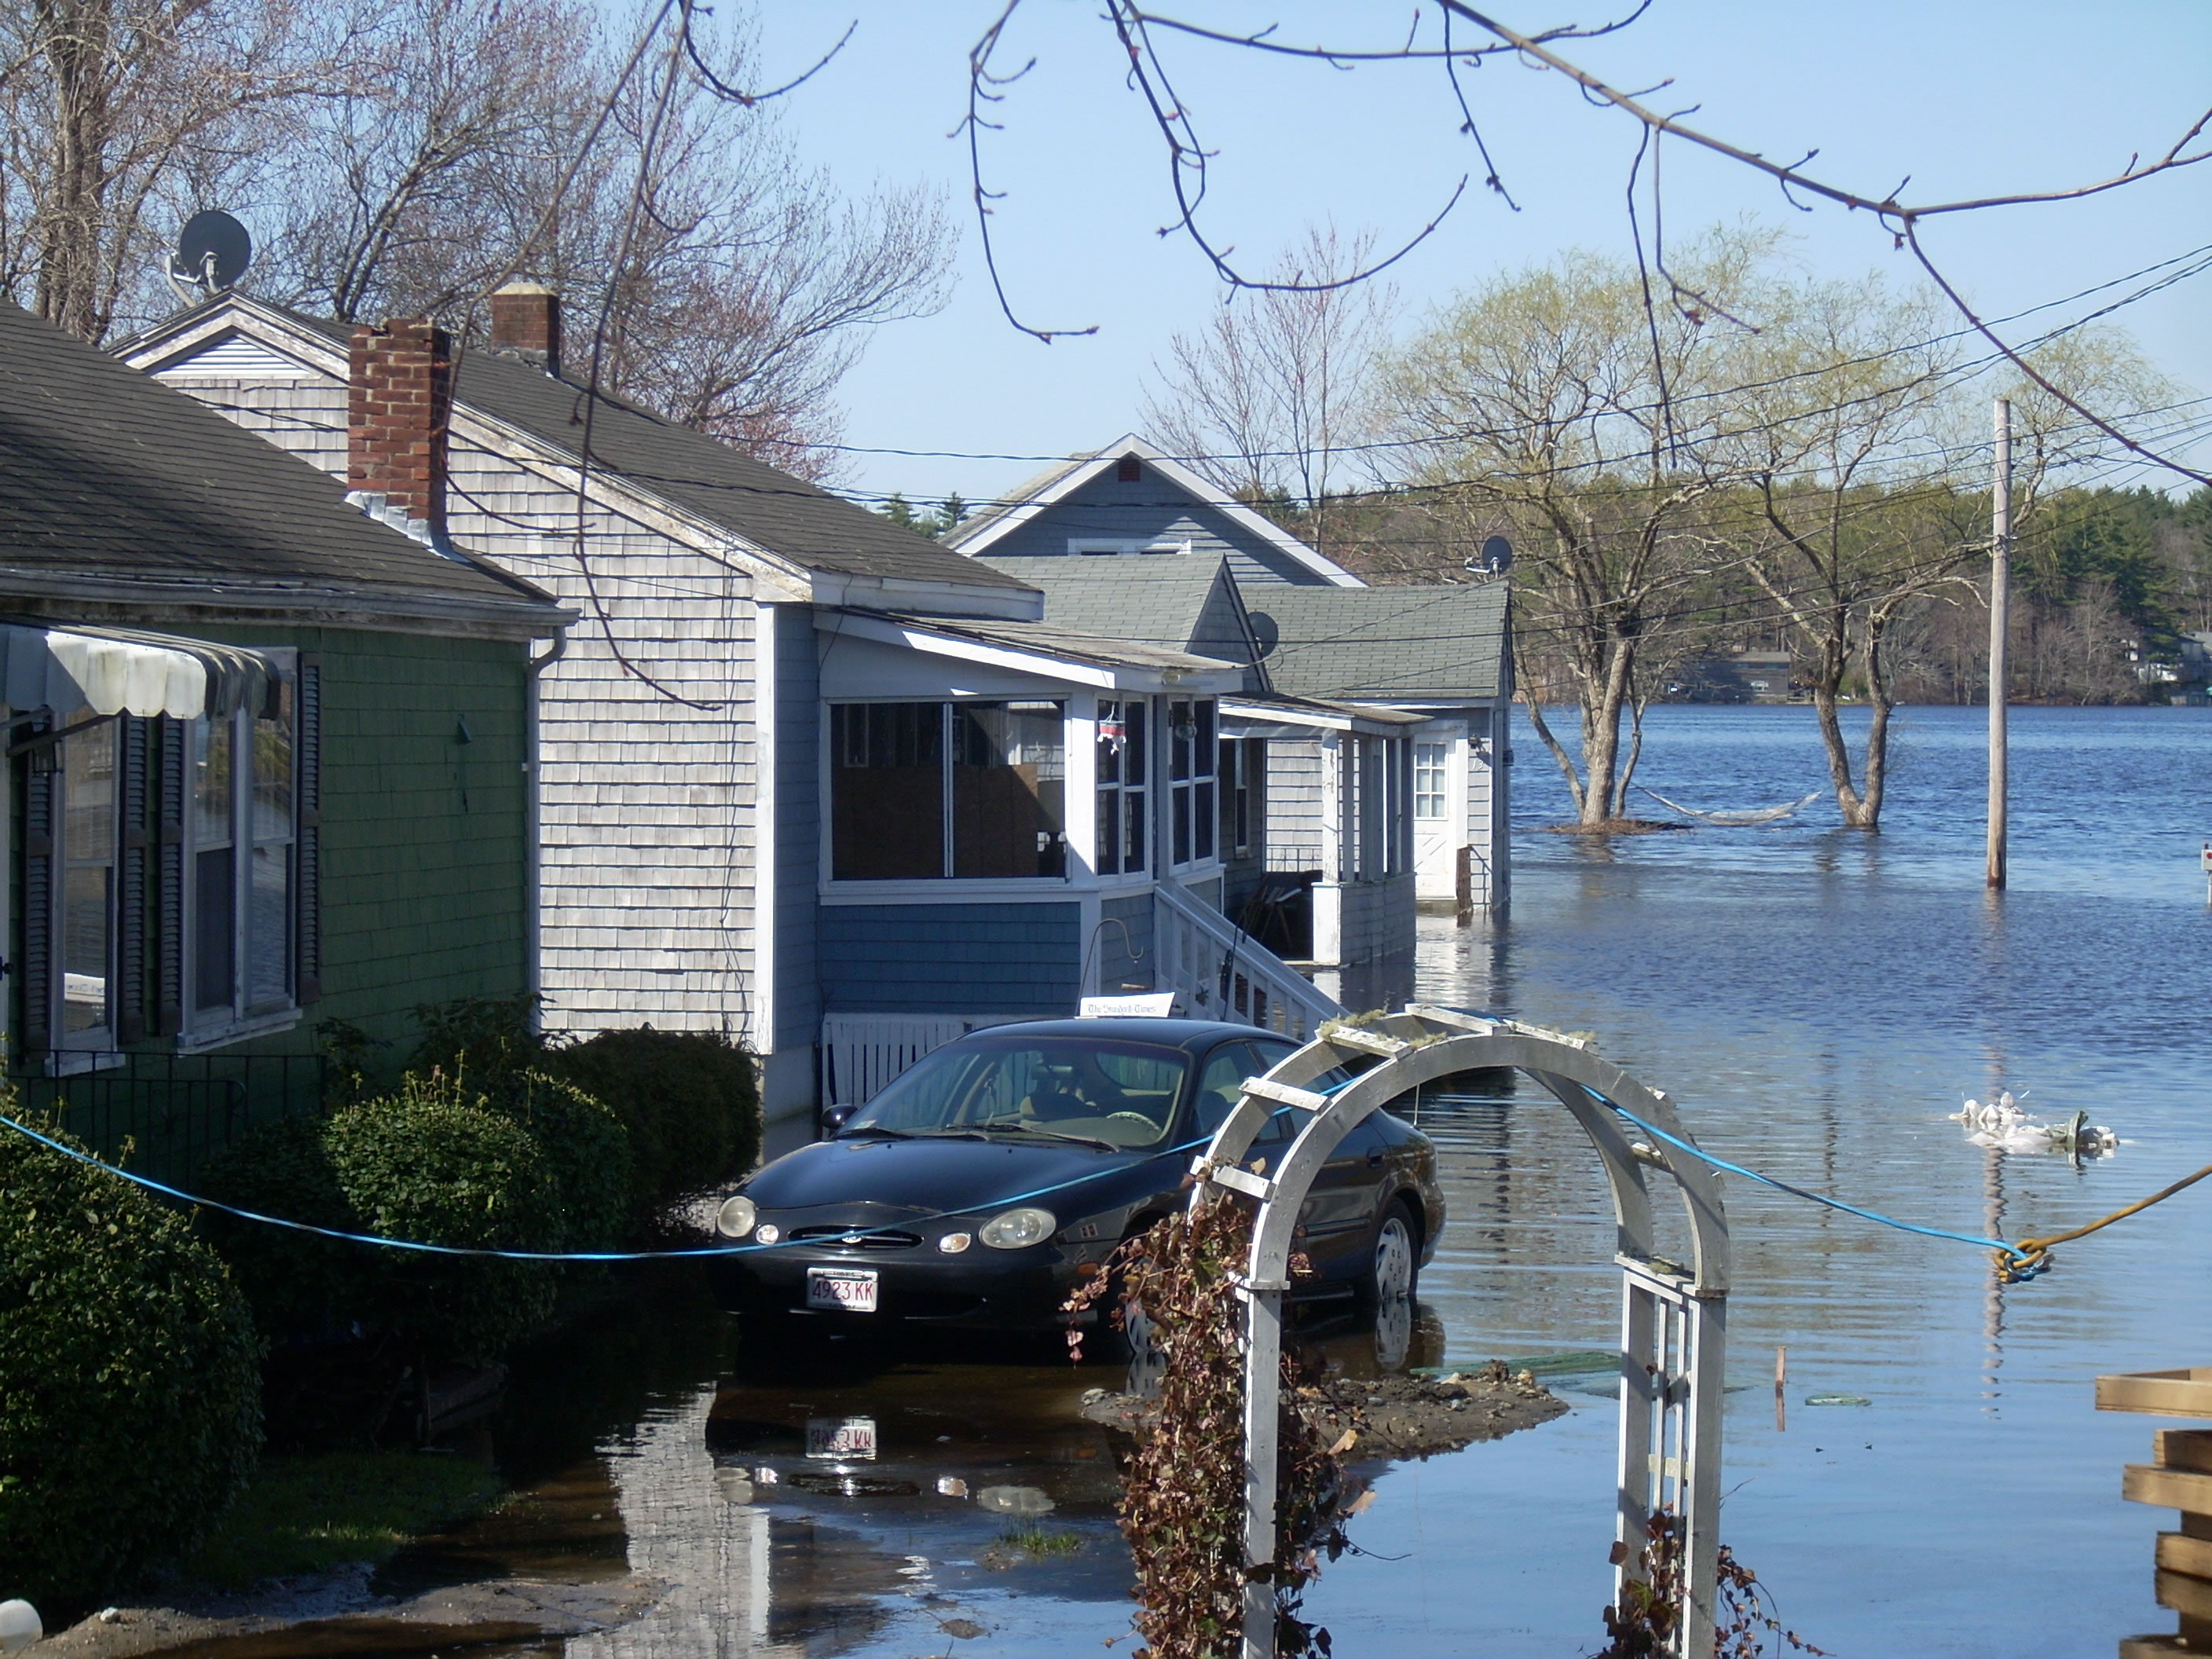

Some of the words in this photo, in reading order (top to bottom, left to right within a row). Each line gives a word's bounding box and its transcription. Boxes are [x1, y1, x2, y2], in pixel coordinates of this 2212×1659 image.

[1088, 1004, 1101, 1013] The
[1103, 1004, 1132, 1013] Standard
[1134, 1004, 1156, 1013] Times
[812, 1280, 851, 1300] 4923
[855, 1282, 873, 1301] KK
